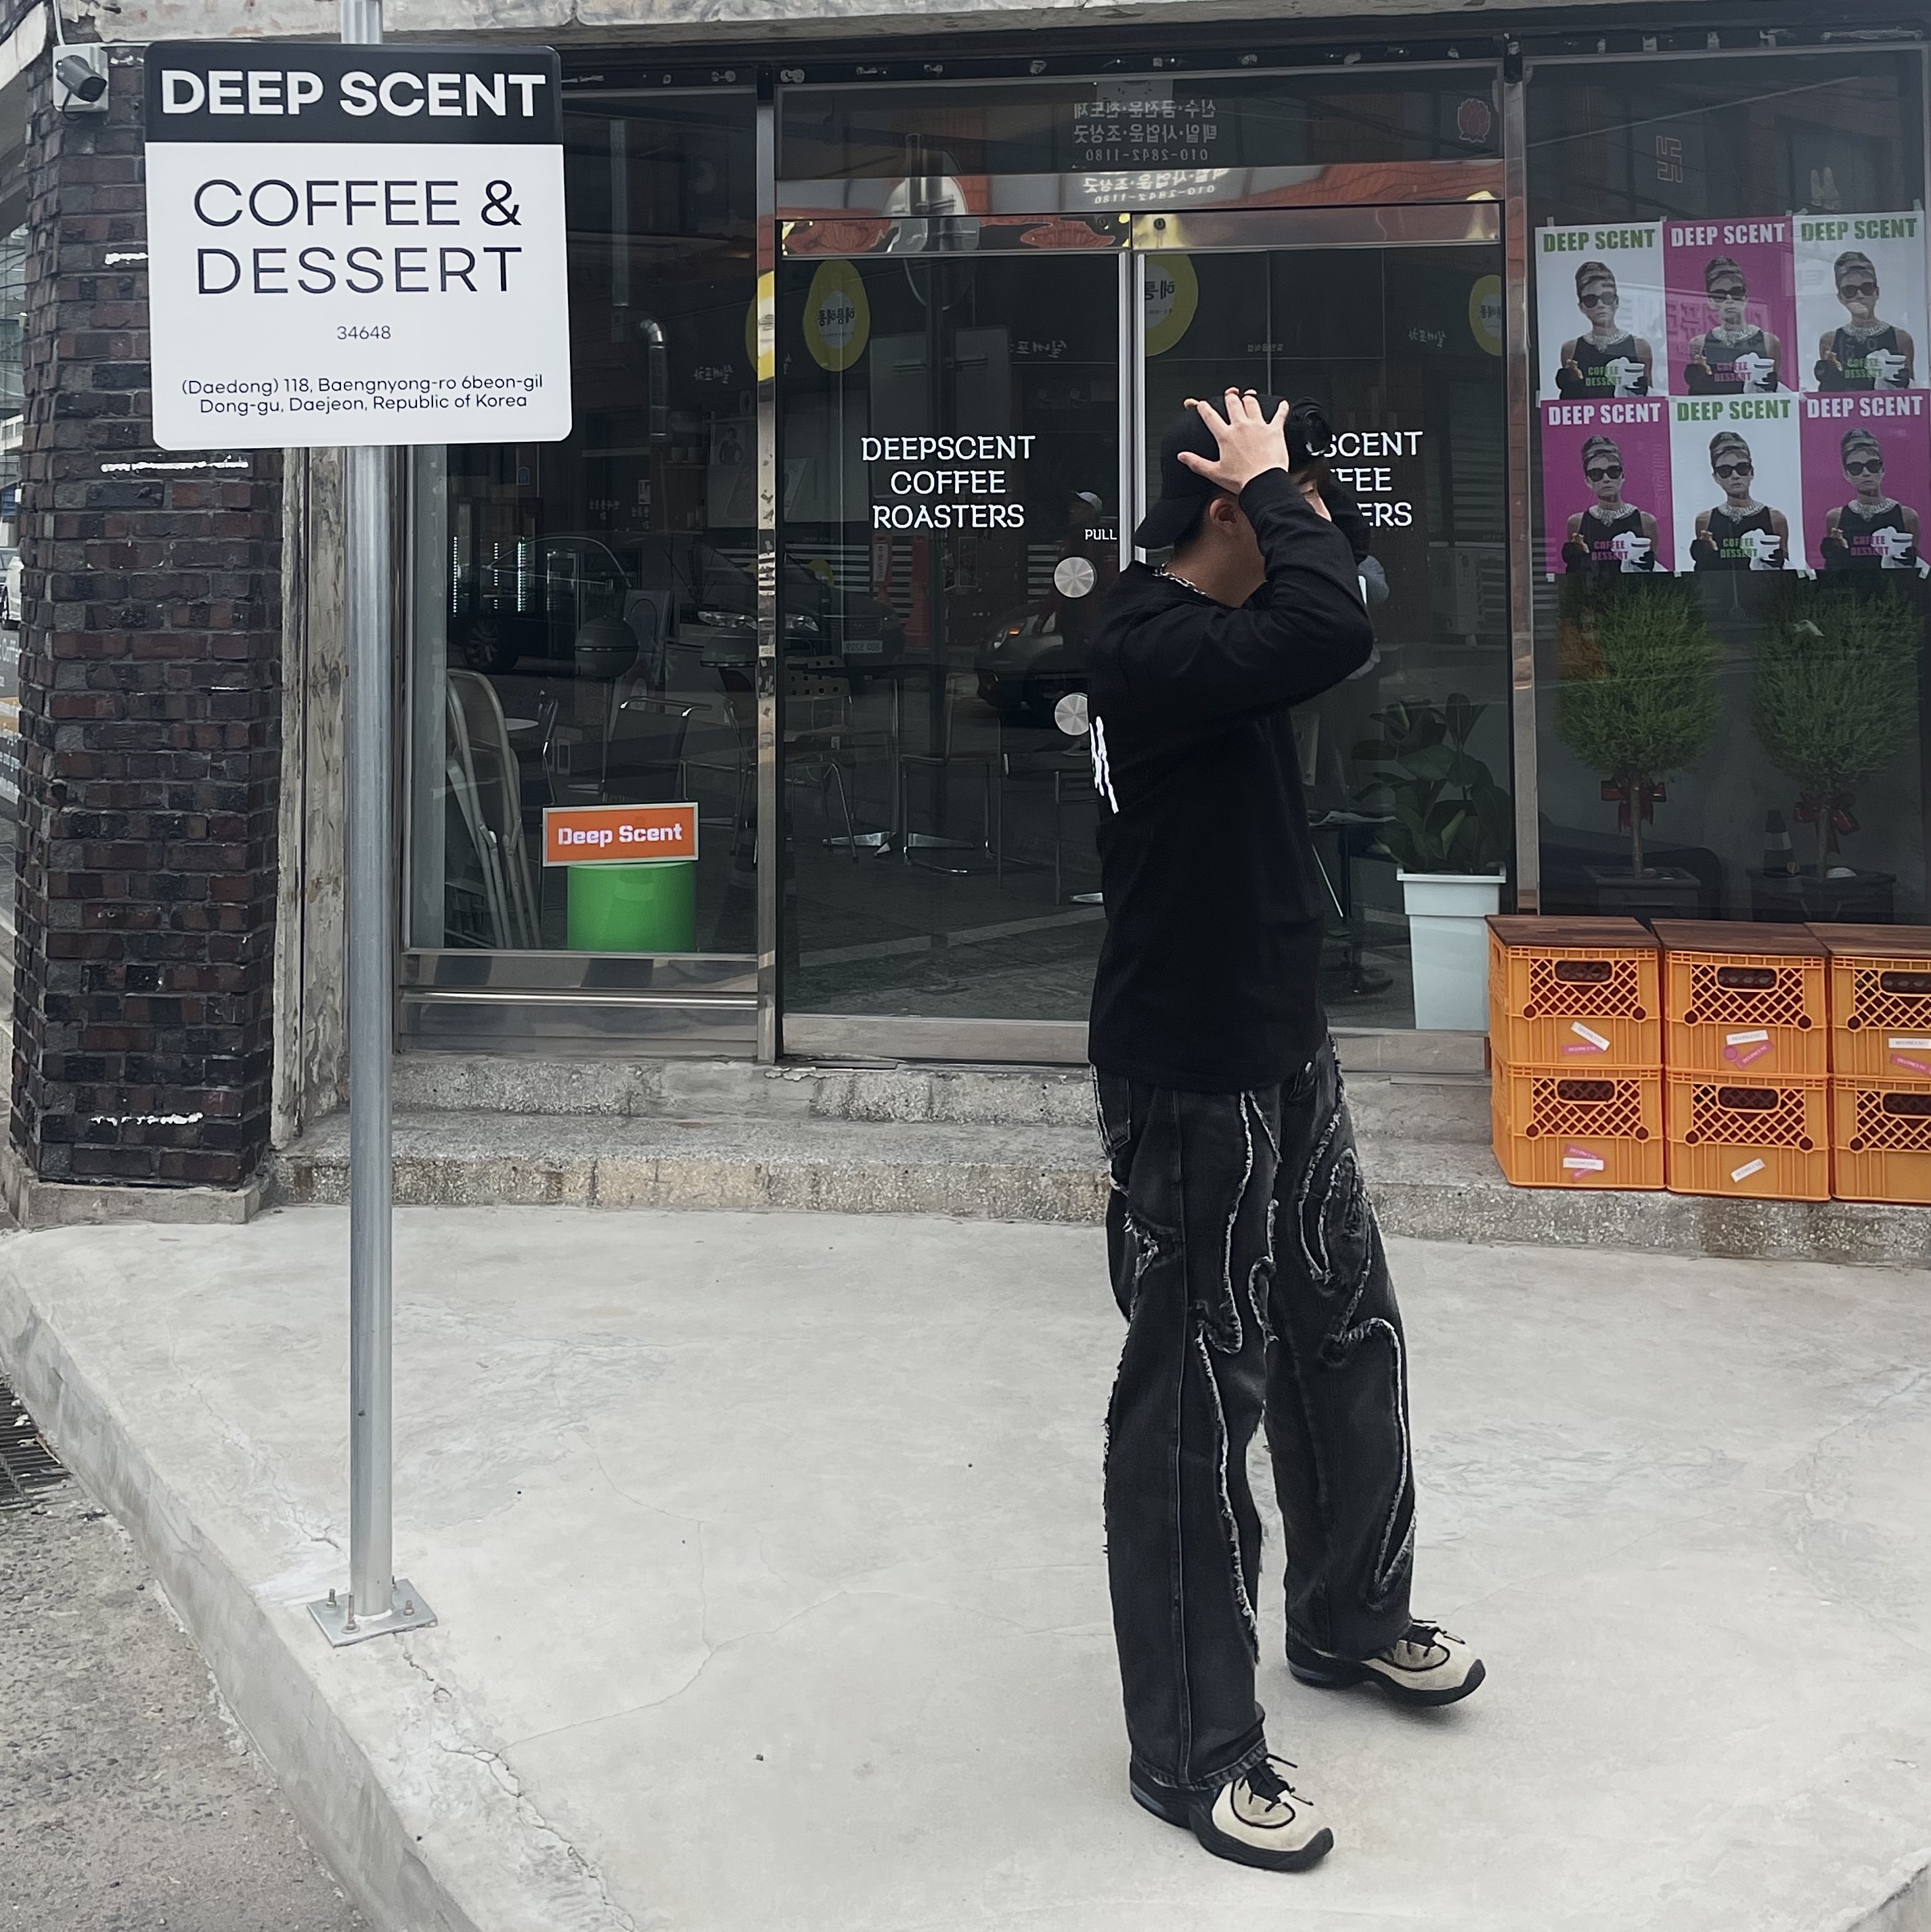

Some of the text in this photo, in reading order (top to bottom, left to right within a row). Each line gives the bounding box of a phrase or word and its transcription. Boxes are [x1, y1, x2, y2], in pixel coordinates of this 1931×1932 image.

[161, 70, 546, 117] DEEP SCENT
[194, 179, 523, 227] COFFEE &
[1543, 229, 1656, 252] DEEP SCENT
[1671, 223, 1785, 247] DEEP SCENT
[1801, 218, 1917, 242] DEEP SCENT
[196, 246, 523, 294] DESSERT
[336, 325, 392, 340] 34648
[181, 375, 543, 397] (Daedong) 118, Baengnyong-ro 6beon-gil
[200, 394, 527, 416] Dong-gu, Daejeon, Republic of Korea
[1549, 401, 1661, 425] DEEP SCENT
[1677, 398, 1791, 420] DEEP SCENT
[1807, 395, 1923, 418] DEEP SCENT
[861, 435, 1036, 461] DEEPSCENT
[891, 470, 1006, 495] COFFEE
[872, 504, 1025, 529] ROASTERS
[1084, 529, 1117, 541] PULL
[1594, 540, 1625, 549] COFFEE
[1723, 538, 1754, 547] COFFEE
[1592, 551, 1628, 560] DESSERT
[1720, 549, 1758, 558] DESSERT
[558, 822, 683, 848] Deep Scent
